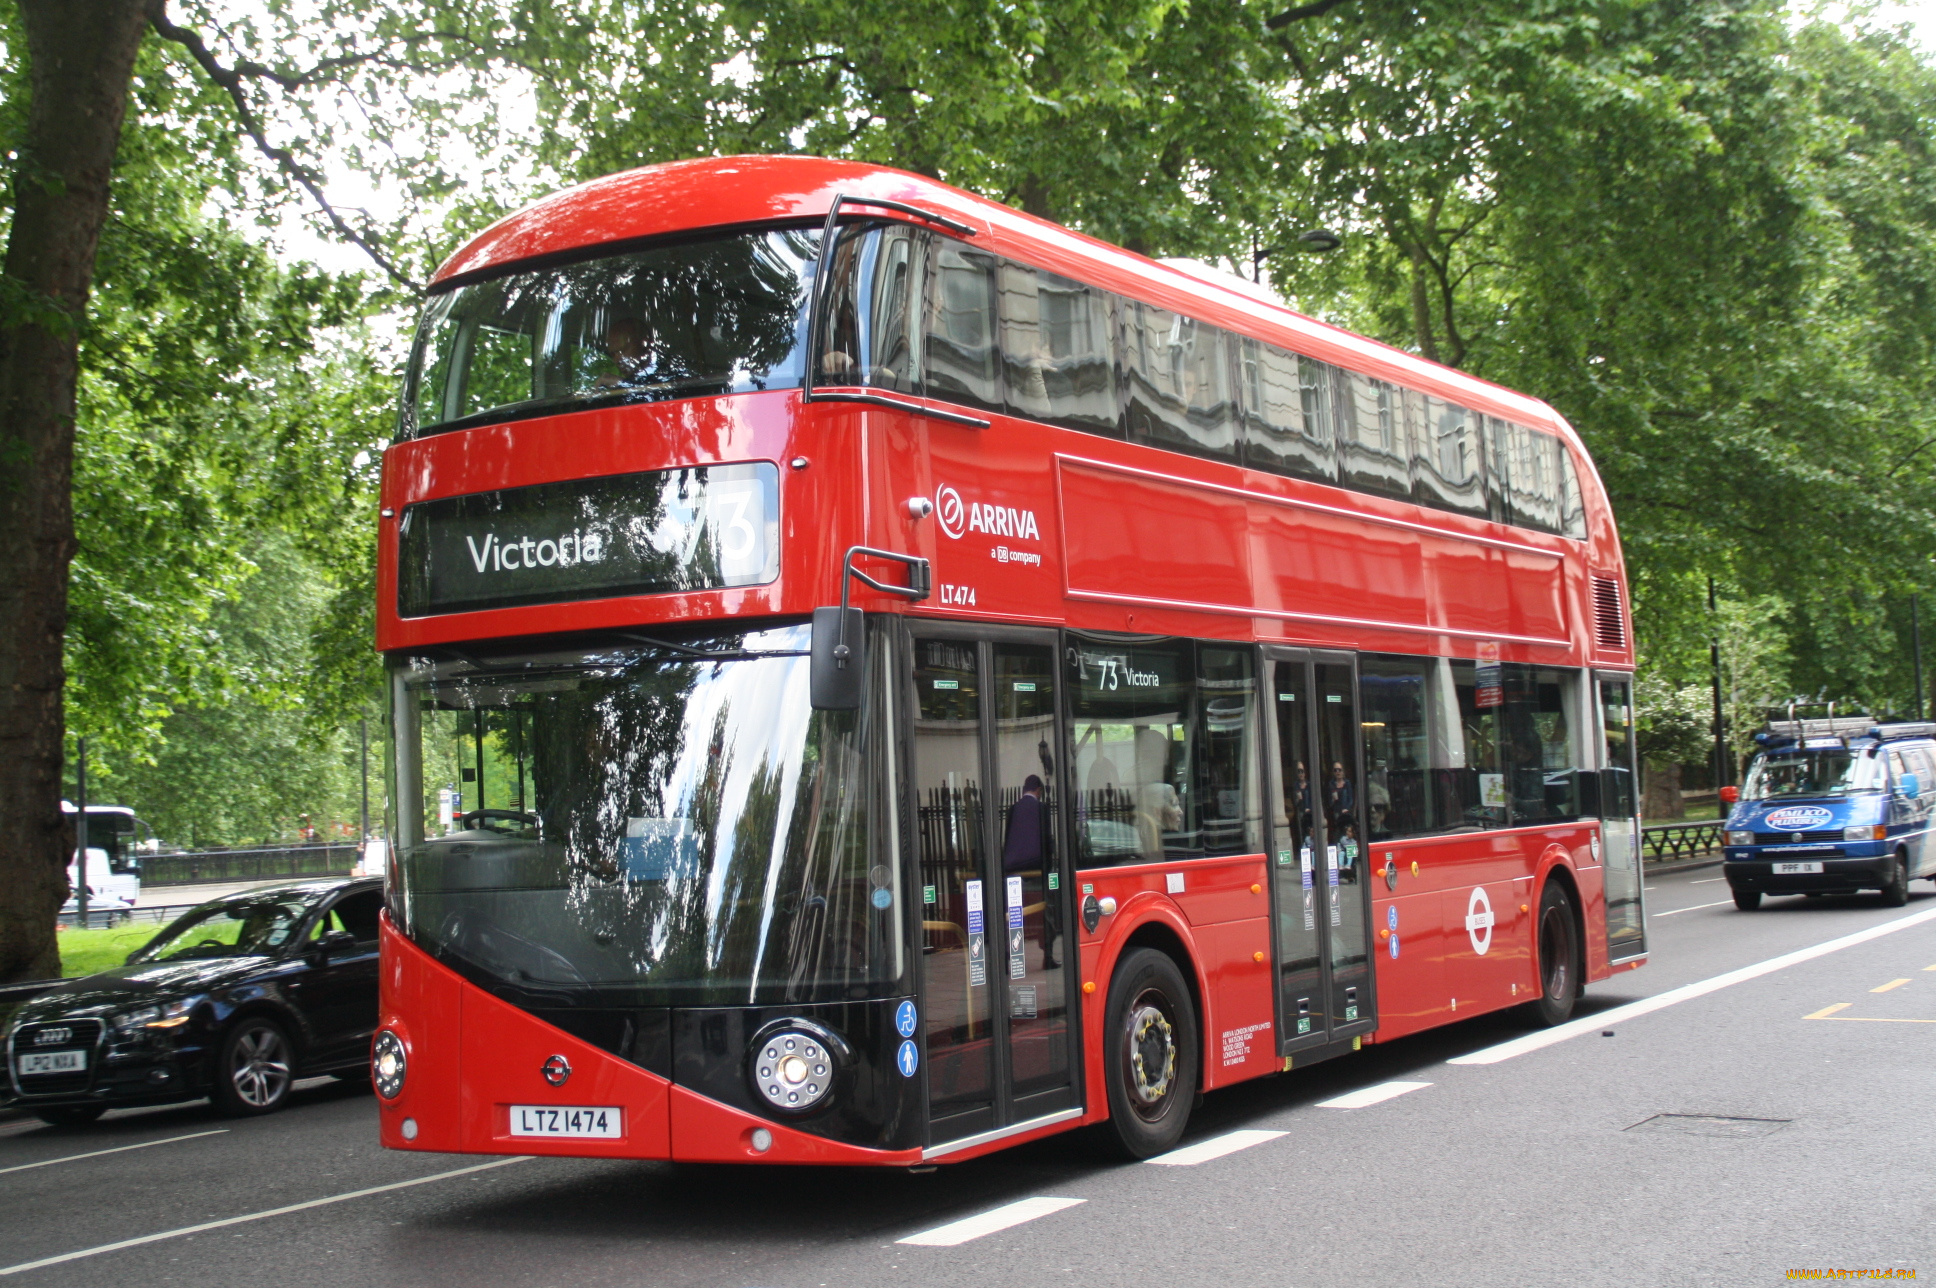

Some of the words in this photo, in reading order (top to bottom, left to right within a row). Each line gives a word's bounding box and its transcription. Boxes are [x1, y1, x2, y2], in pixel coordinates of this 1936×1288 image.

[676, 490, 756, 566] 73
[969, 502, 1040, 540] ARRIVA
[466, 527, 601, 573] Victoria
[991, 549, 996, 558] a
[998, 547, 1008, 561] DB
[1009, 550, 1041, 567] company
[940, 584, 976, 606] LT474
[1098, 660, 1118, 691] 73
[1125, 667, 1159, 687] Victoria
[1772, 818, 1825, 826] PLUMBERS
[1774, 809, 1826, 818] PIMLICO
